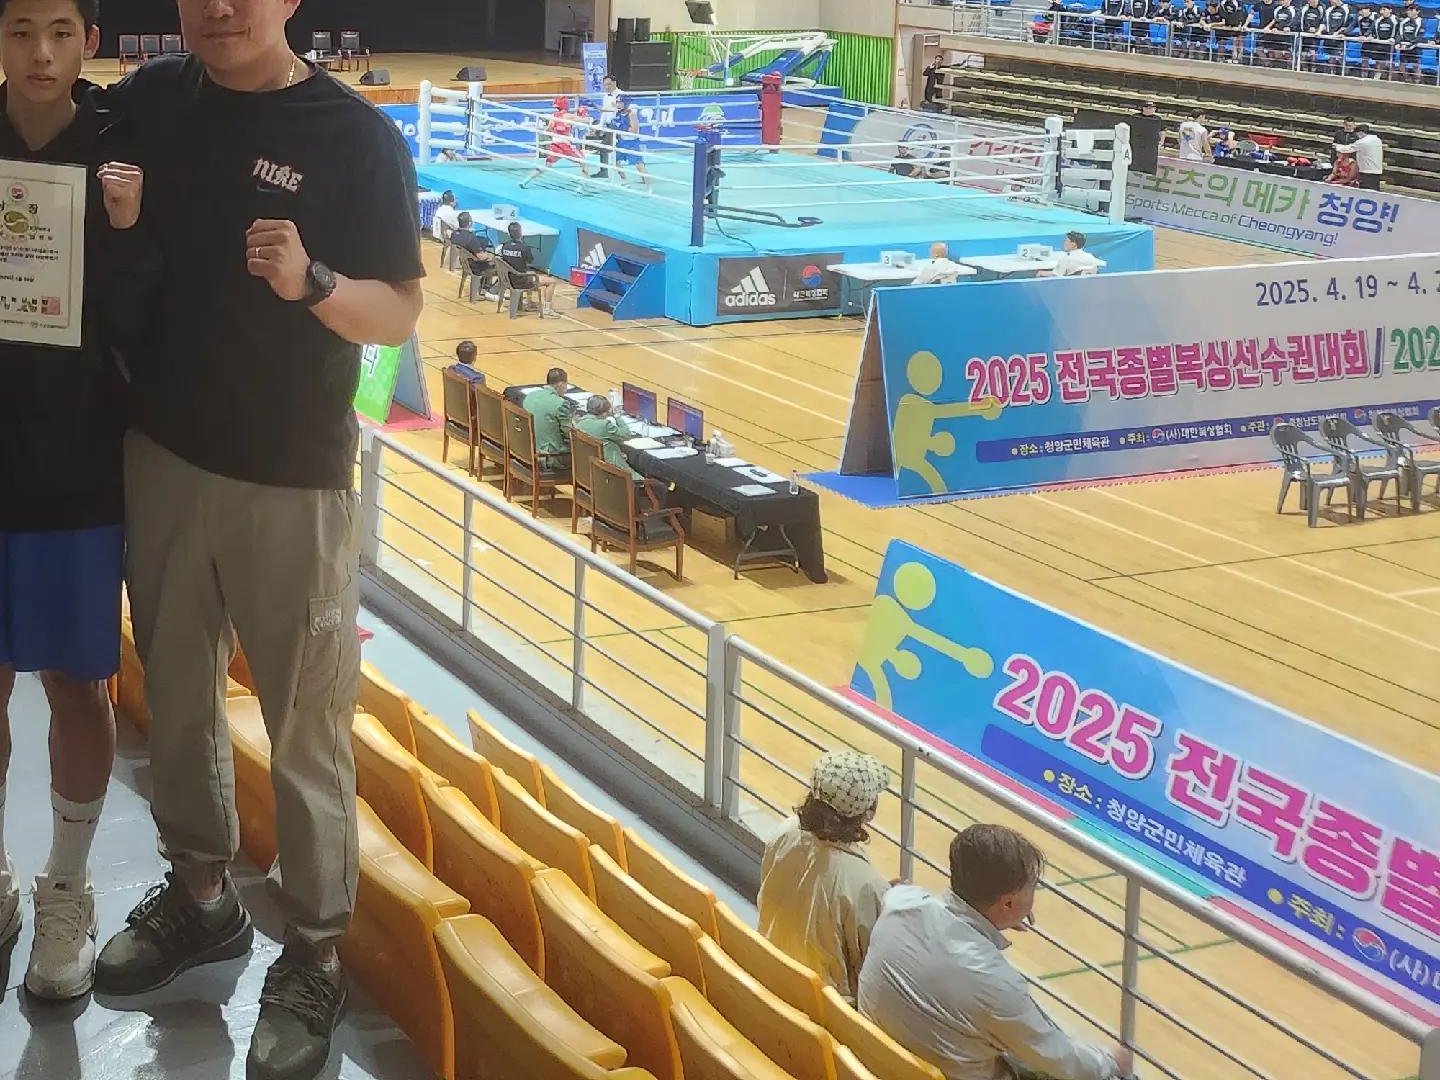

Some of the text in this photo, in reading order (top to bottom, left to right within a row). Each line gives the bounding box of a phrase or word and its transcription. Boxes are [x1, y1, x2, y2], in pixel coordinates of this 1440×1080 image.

[1126, 194, 1338, 247] Sports Mecca of Cheongyang!
[1243, 179, 1311, 220] 메카
[725, 291, 776, 308] adidas
[1255, 278, 1318, 306] 2025.
[1326, 277, 1346, 302] 4.
[1355, 274, 1378, 299] 19
[1407, 271, 1427, 295] 4.
[965, 354, 1050, 407] 2025
[1054, 328, 1371, 403] 전국종별복싱선수권대회
[997, 657, 1440, 937] 2025 전국종별
[1107, 798, 1248, 887] 청양군민체육관
